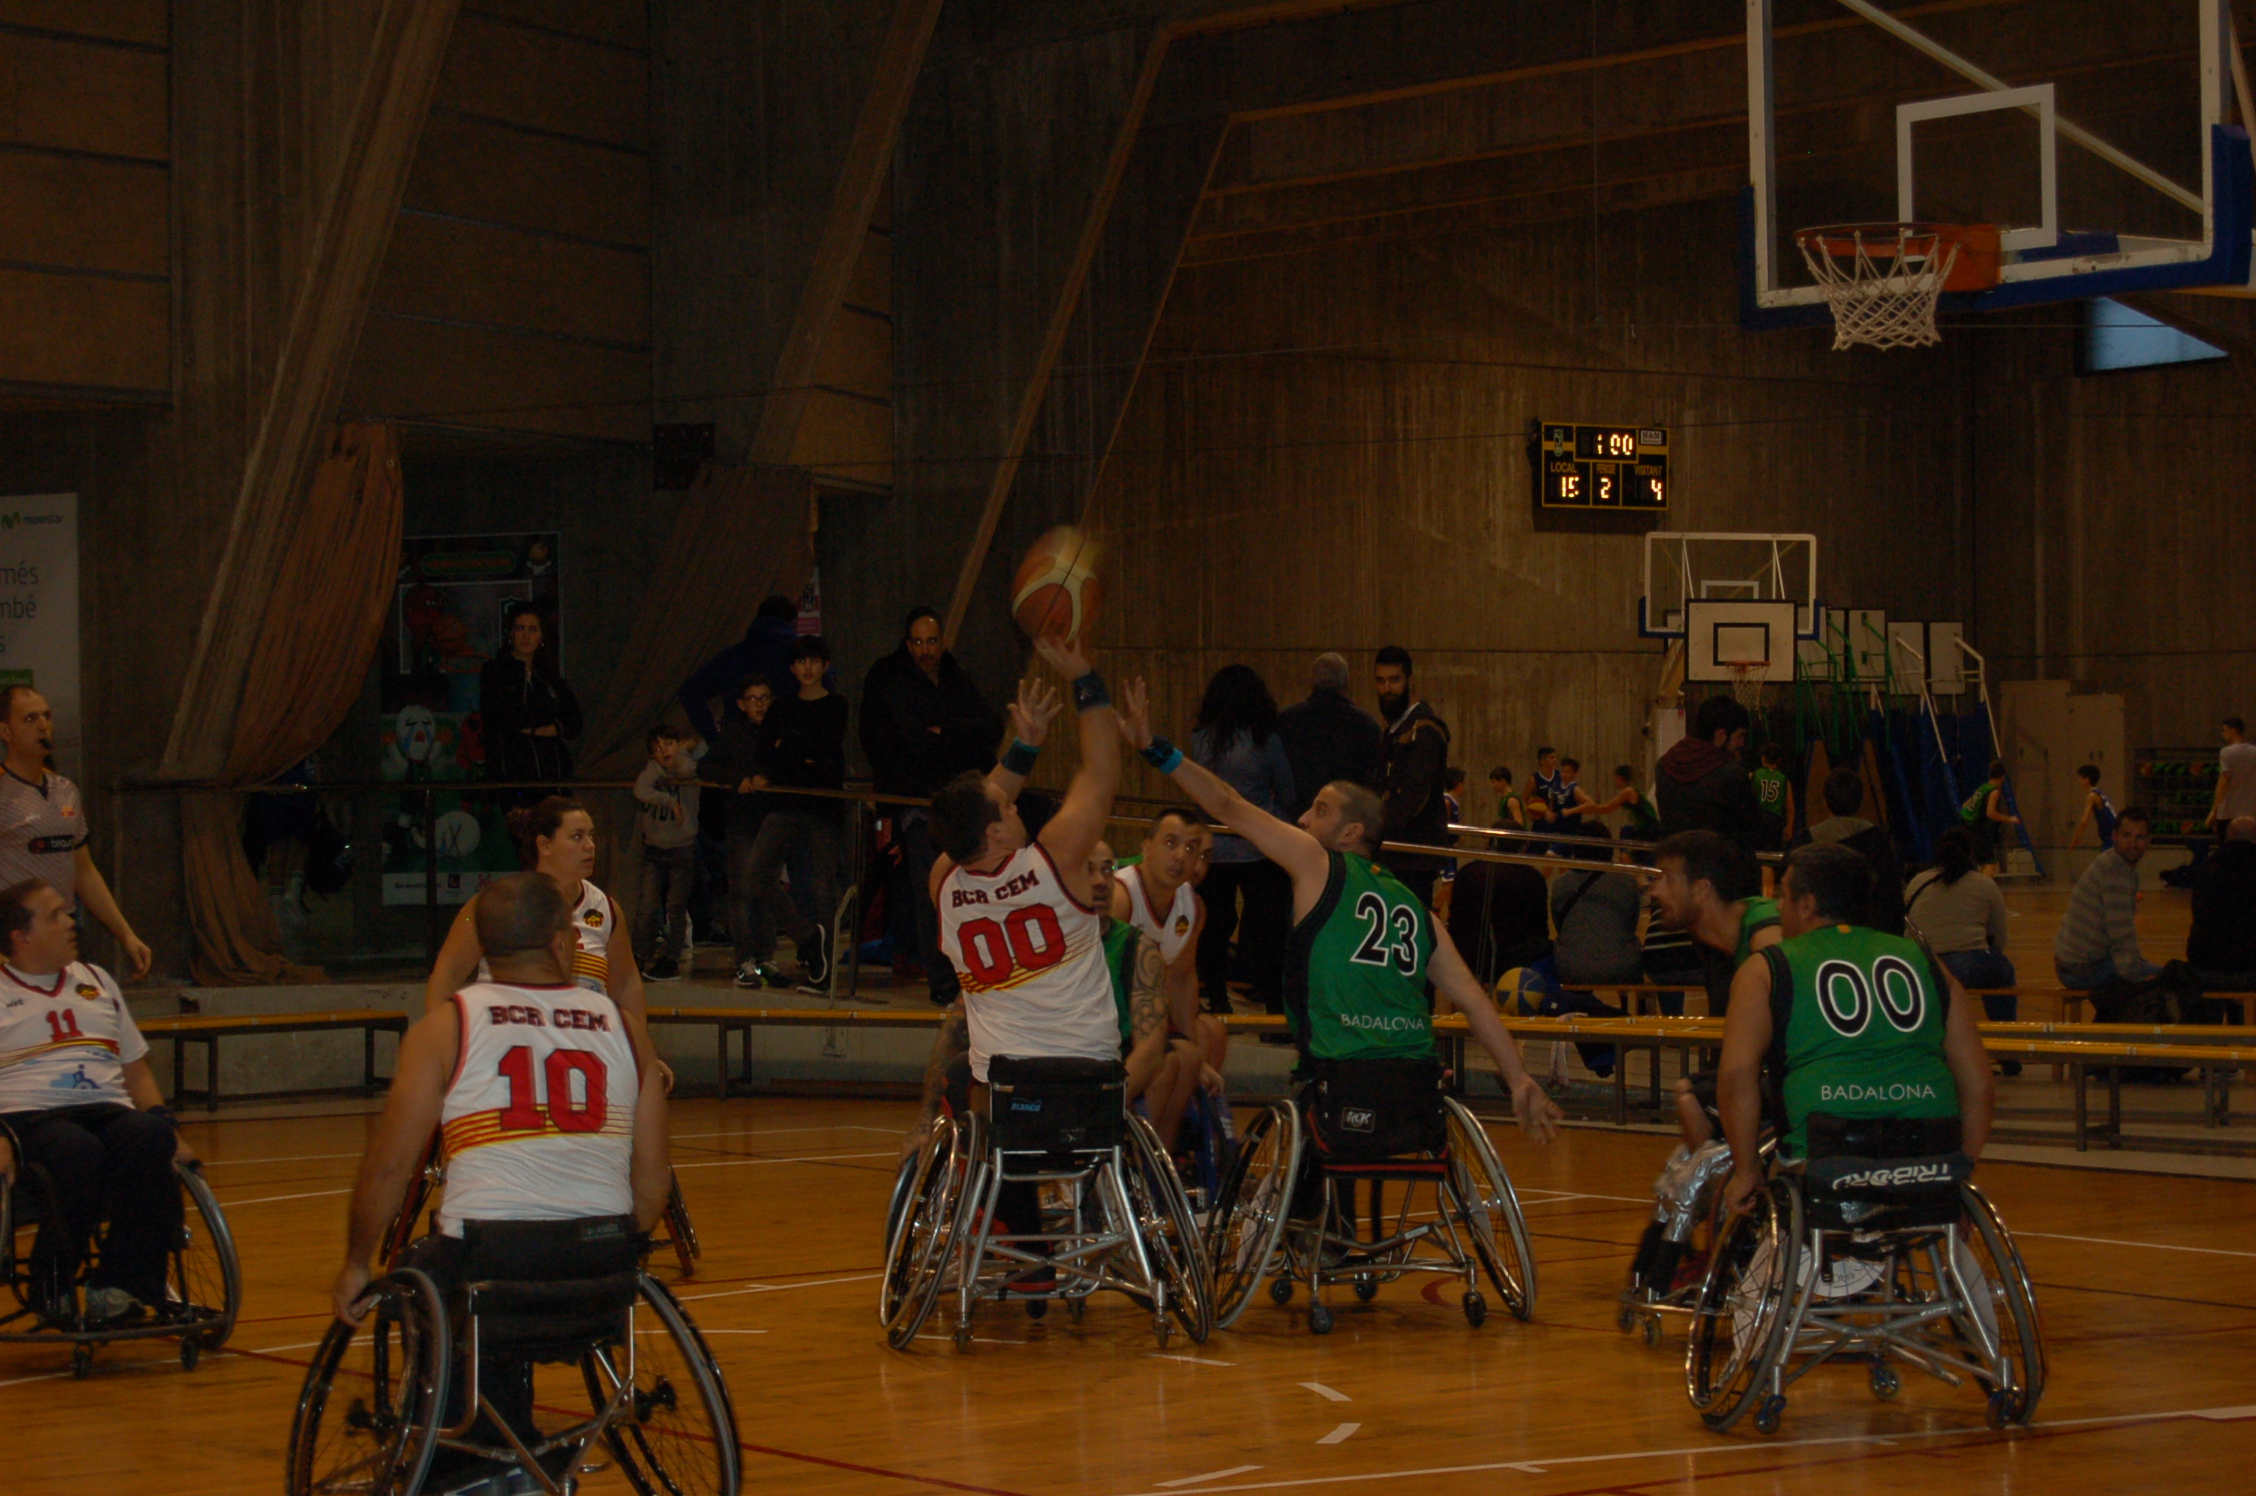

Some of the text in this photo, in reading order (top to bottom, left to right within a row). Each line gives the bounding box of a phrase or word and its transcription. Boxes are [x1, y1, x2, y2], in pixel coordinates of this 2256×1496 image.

[1550, 462, 1578, 473] LOCAL
[1633, 465, 1663, 477] VISITANT
[1561, 476, 1579, 498] 15
[1600, 477, 1612, 499] 2
[1650, 478, 1663, 501] 4
[22, 514, 64, 525] movistar
[1760, 779, 1780, 803] 15
[952, 869, 1040, 908] BCR CEM
[957, 903, 1067, 985] 00
[1349, 891, 1418, 976] 23
[1815, 955, 1926, 1037] 00
[46, 1008, 84, 1042] 11
[489, 1006, 610, 1032] BCR CEM
[1340, 1012, 1425, 1031] BADALONA
[498, 1046, 608, 1132] 10
[1820, 1084, 1937, 1101] BADALONA
